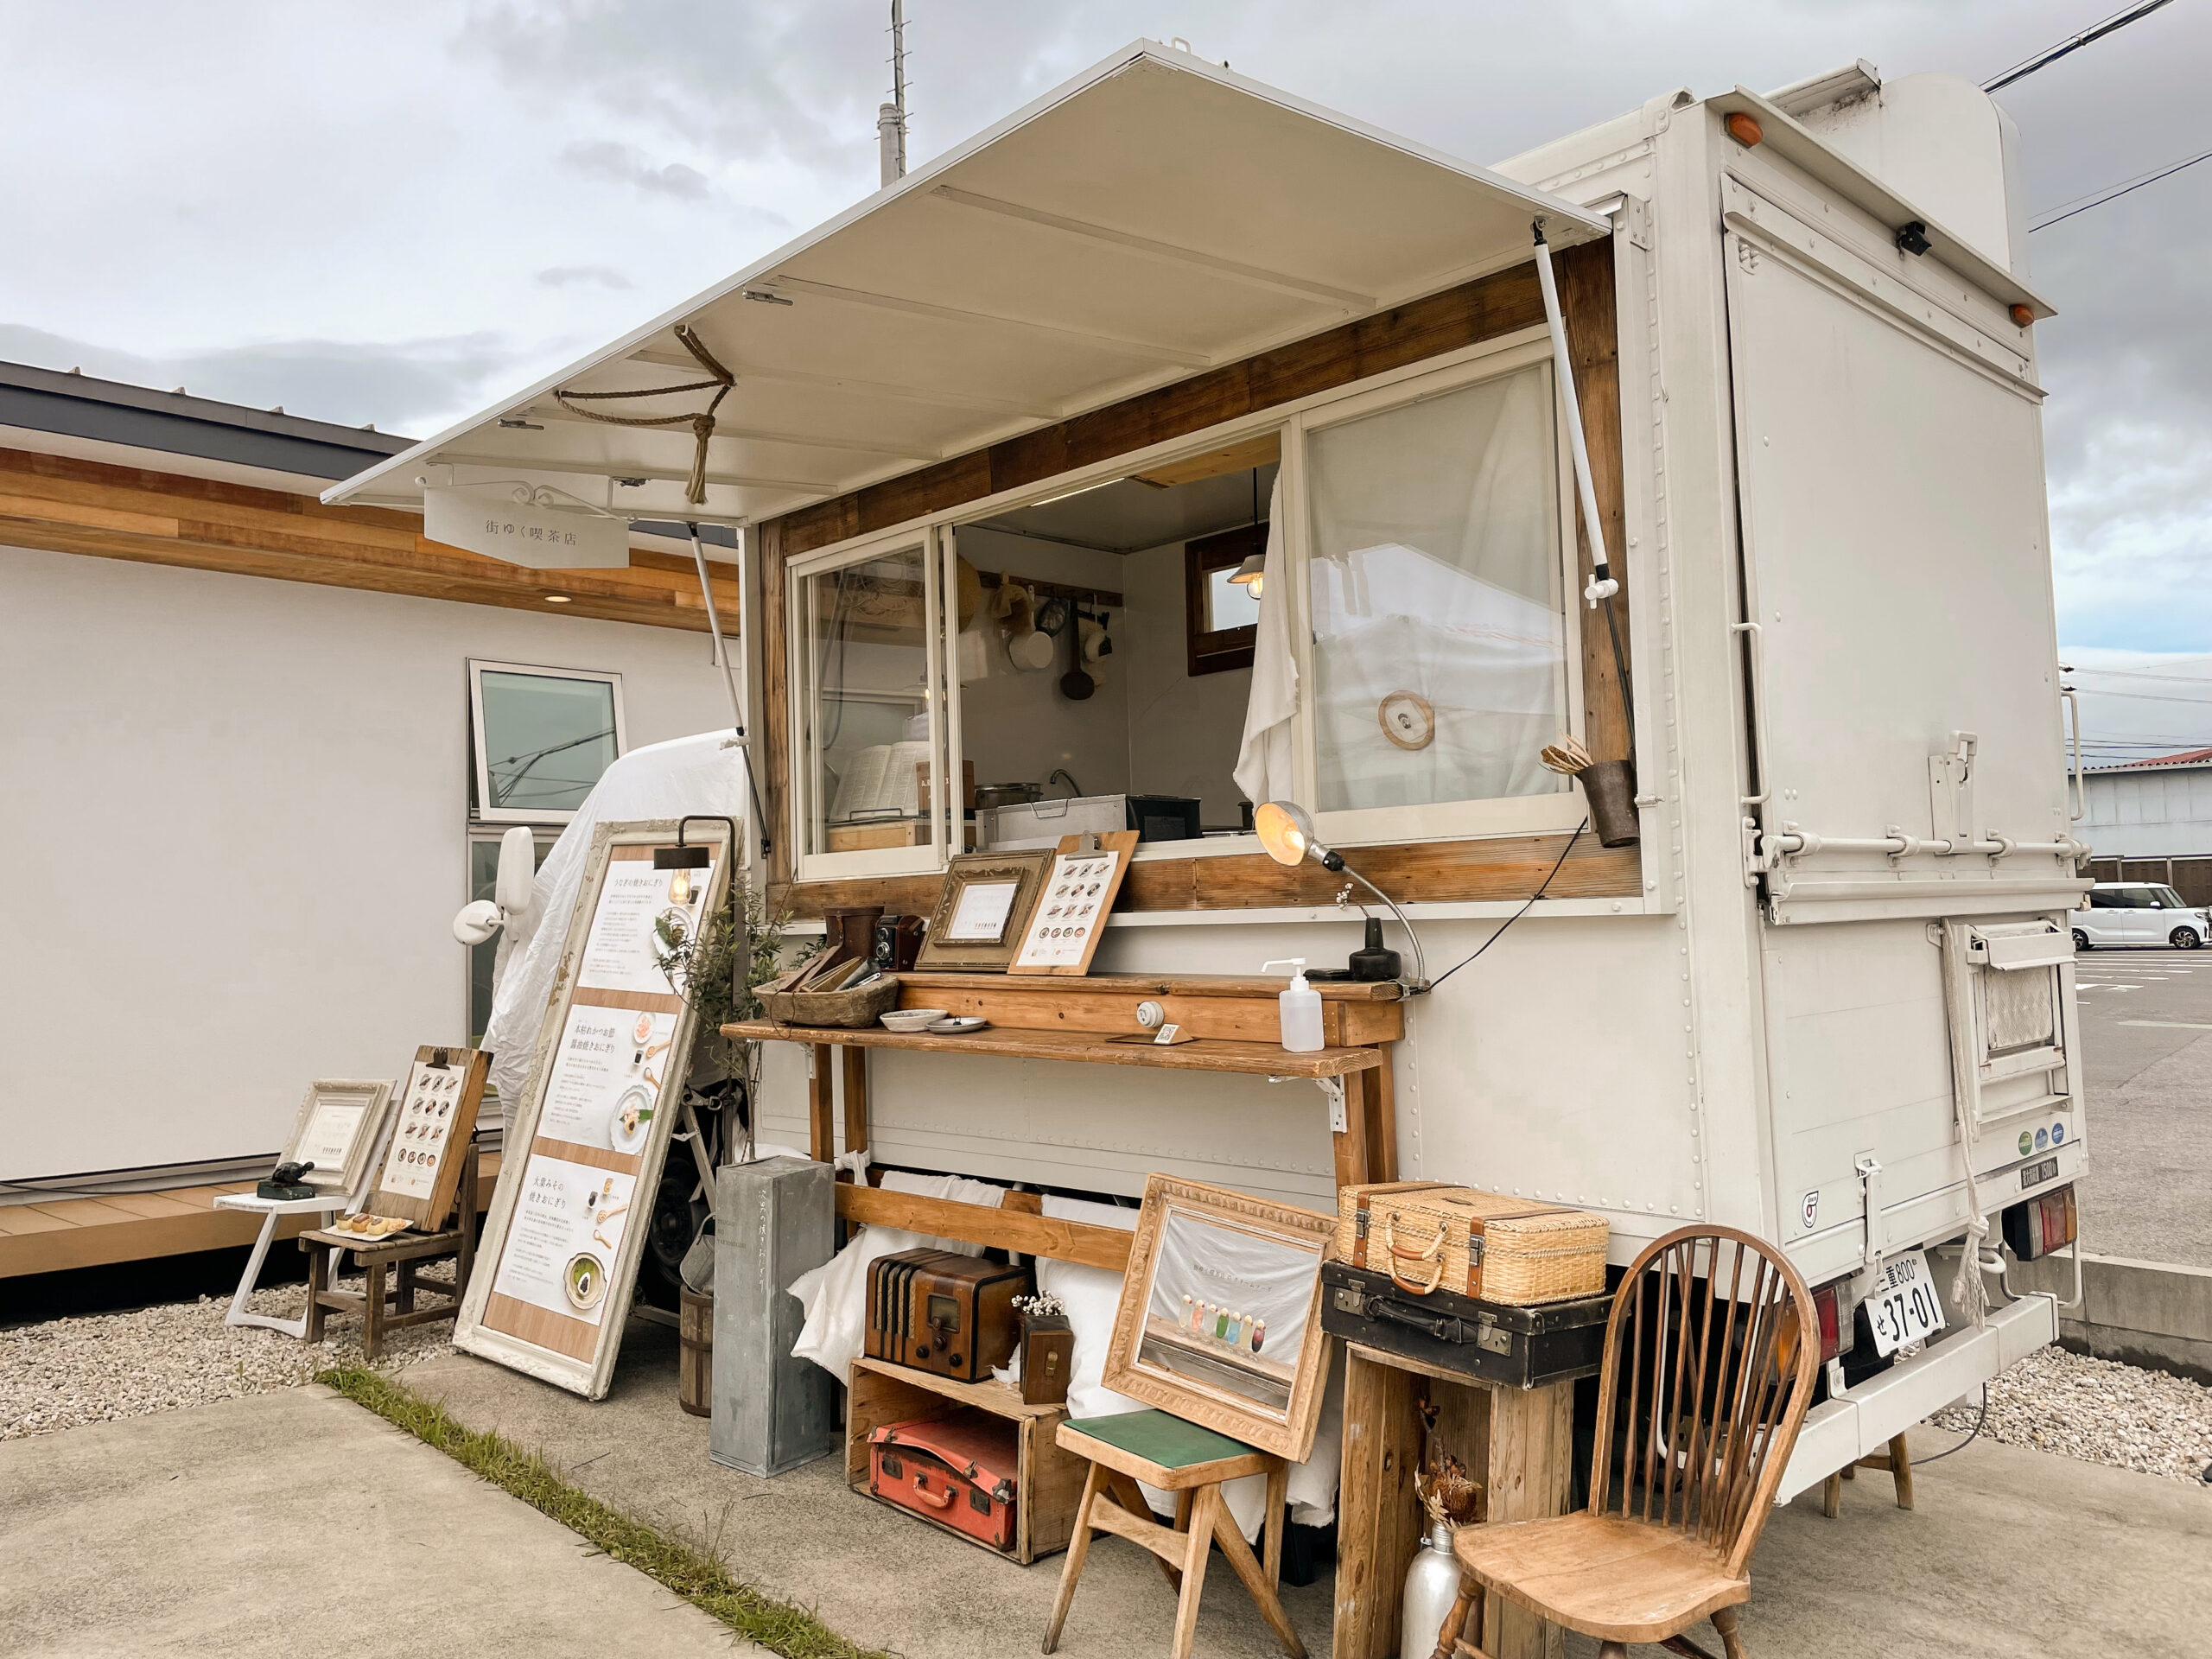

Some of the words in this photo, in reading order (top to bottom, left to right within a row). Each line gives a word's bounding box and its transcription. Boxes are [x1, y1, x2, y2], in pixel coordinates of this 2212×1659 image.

[486, 519, 577, 546] 街ゆく喫茶店
[575, 1024, 615, 1038] 本枯れかつお節
[570, 1039, 615, 1053] 醤油焼きおにぎり
[533, 1176, 563, 1192] 大葉みその
[529, 1192, 566, 1209] 焼きおにぎり
